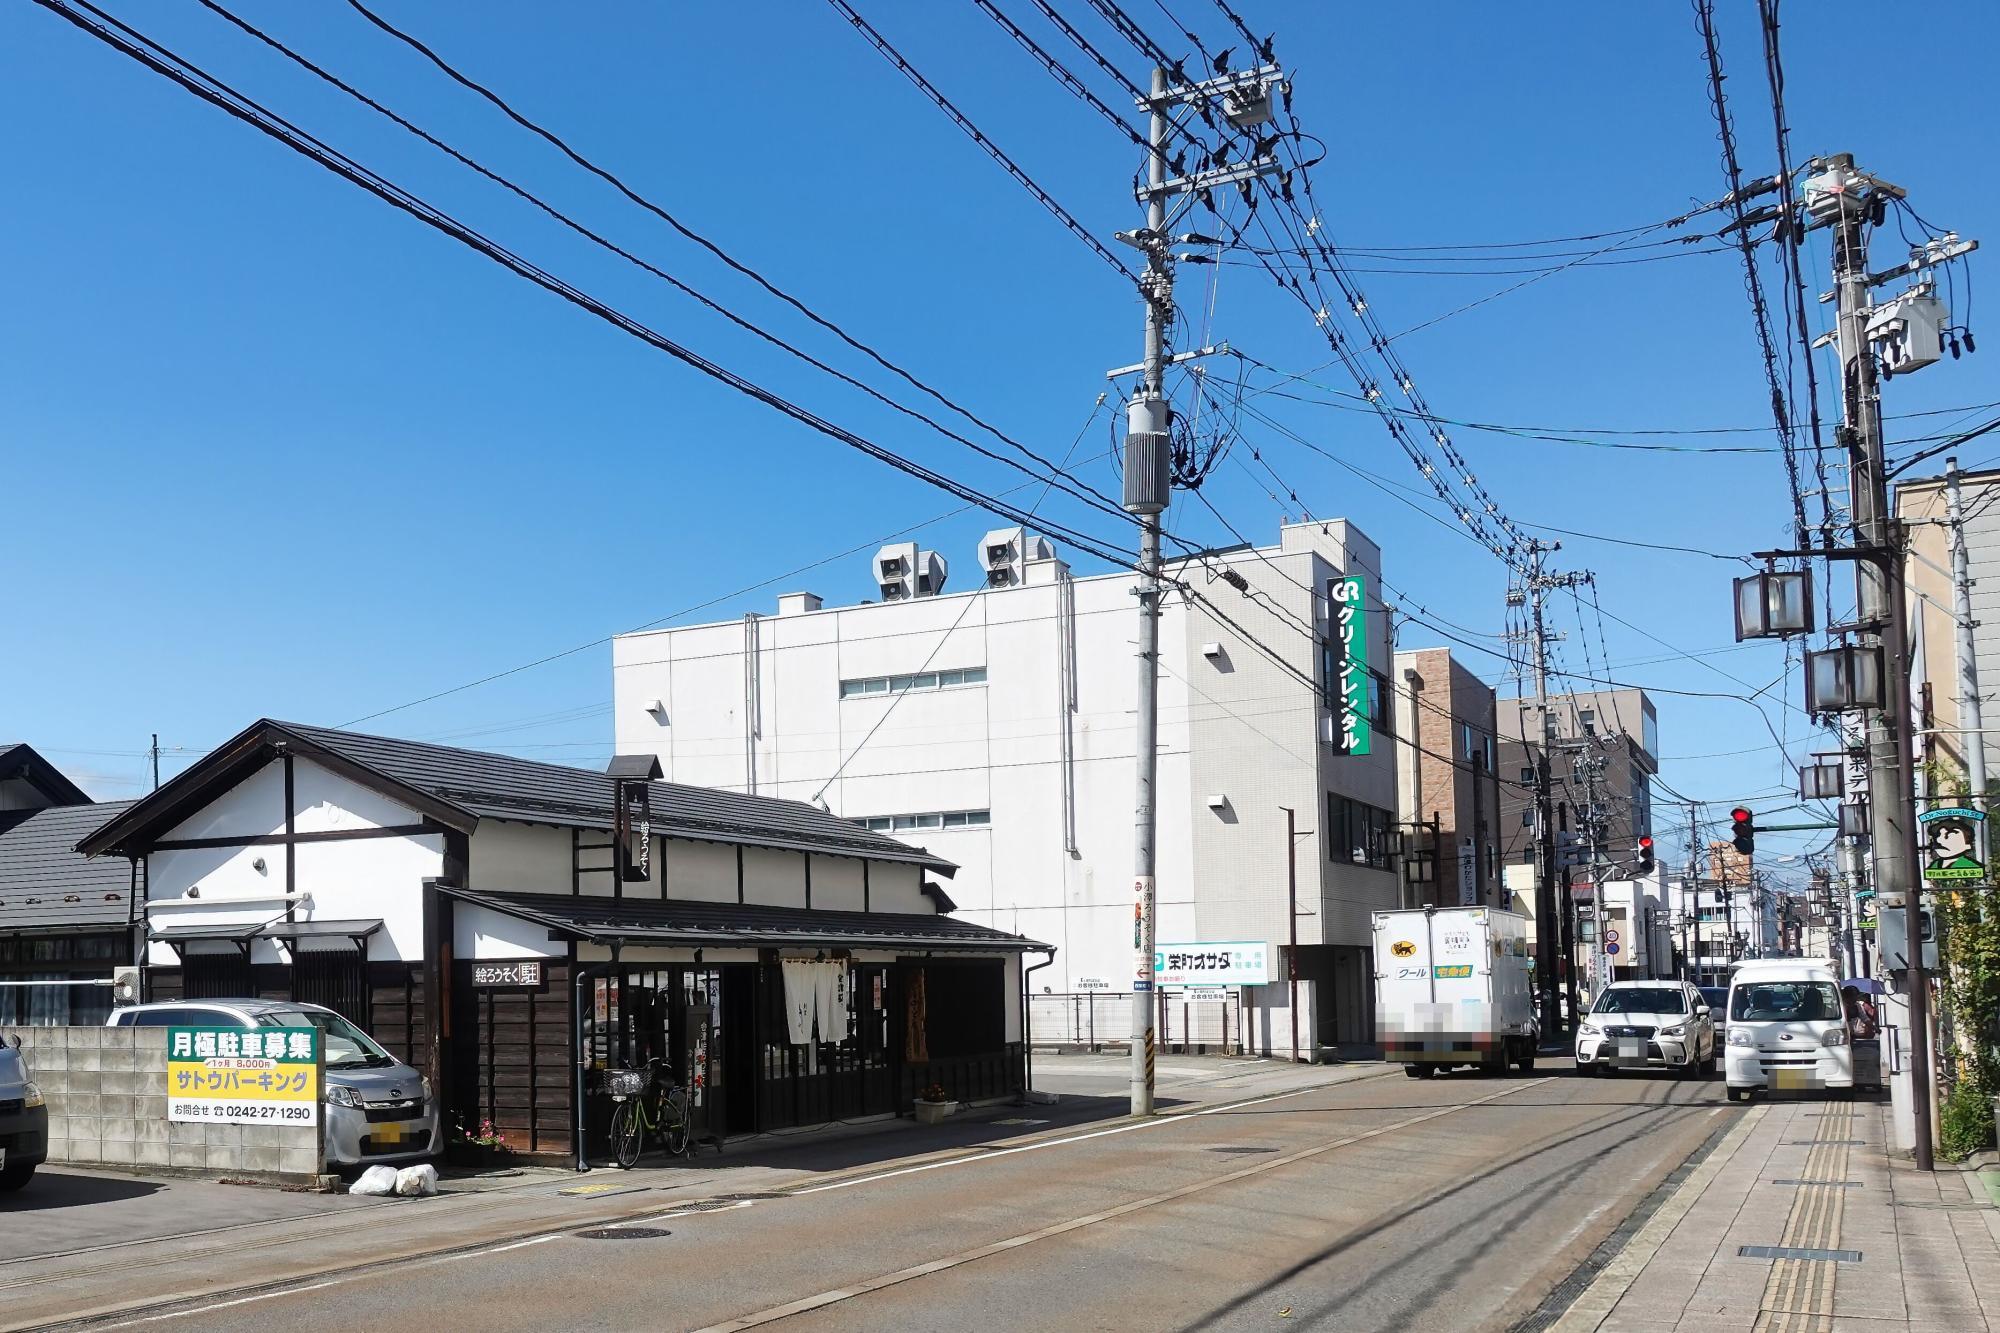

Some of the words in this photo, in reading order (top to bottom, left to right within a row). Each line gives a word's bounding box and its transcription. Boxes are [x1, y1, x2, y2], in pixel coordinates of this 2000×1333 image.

[1332, 581, 1359, 602] GR
[1338, 605, 1360, 750] グリーンレンタル
[640, 820, 650, 877] 絵ろうそく
[1168, 951, 1232, 970] 栄町オサダ
[475, 967, 518, 983] 絵ろうそく
[521, 964, 537, 984] 駐
[1399, 968, 1427, 979] クール
[172, 1032, 312, 1059] 月極駐車募集
[212, 1060, 230, 1068] 1ヶ月
[177, 1070, 308, 1092] サトウパーキング
[174, 1104, 209, 1116] お問合せ
